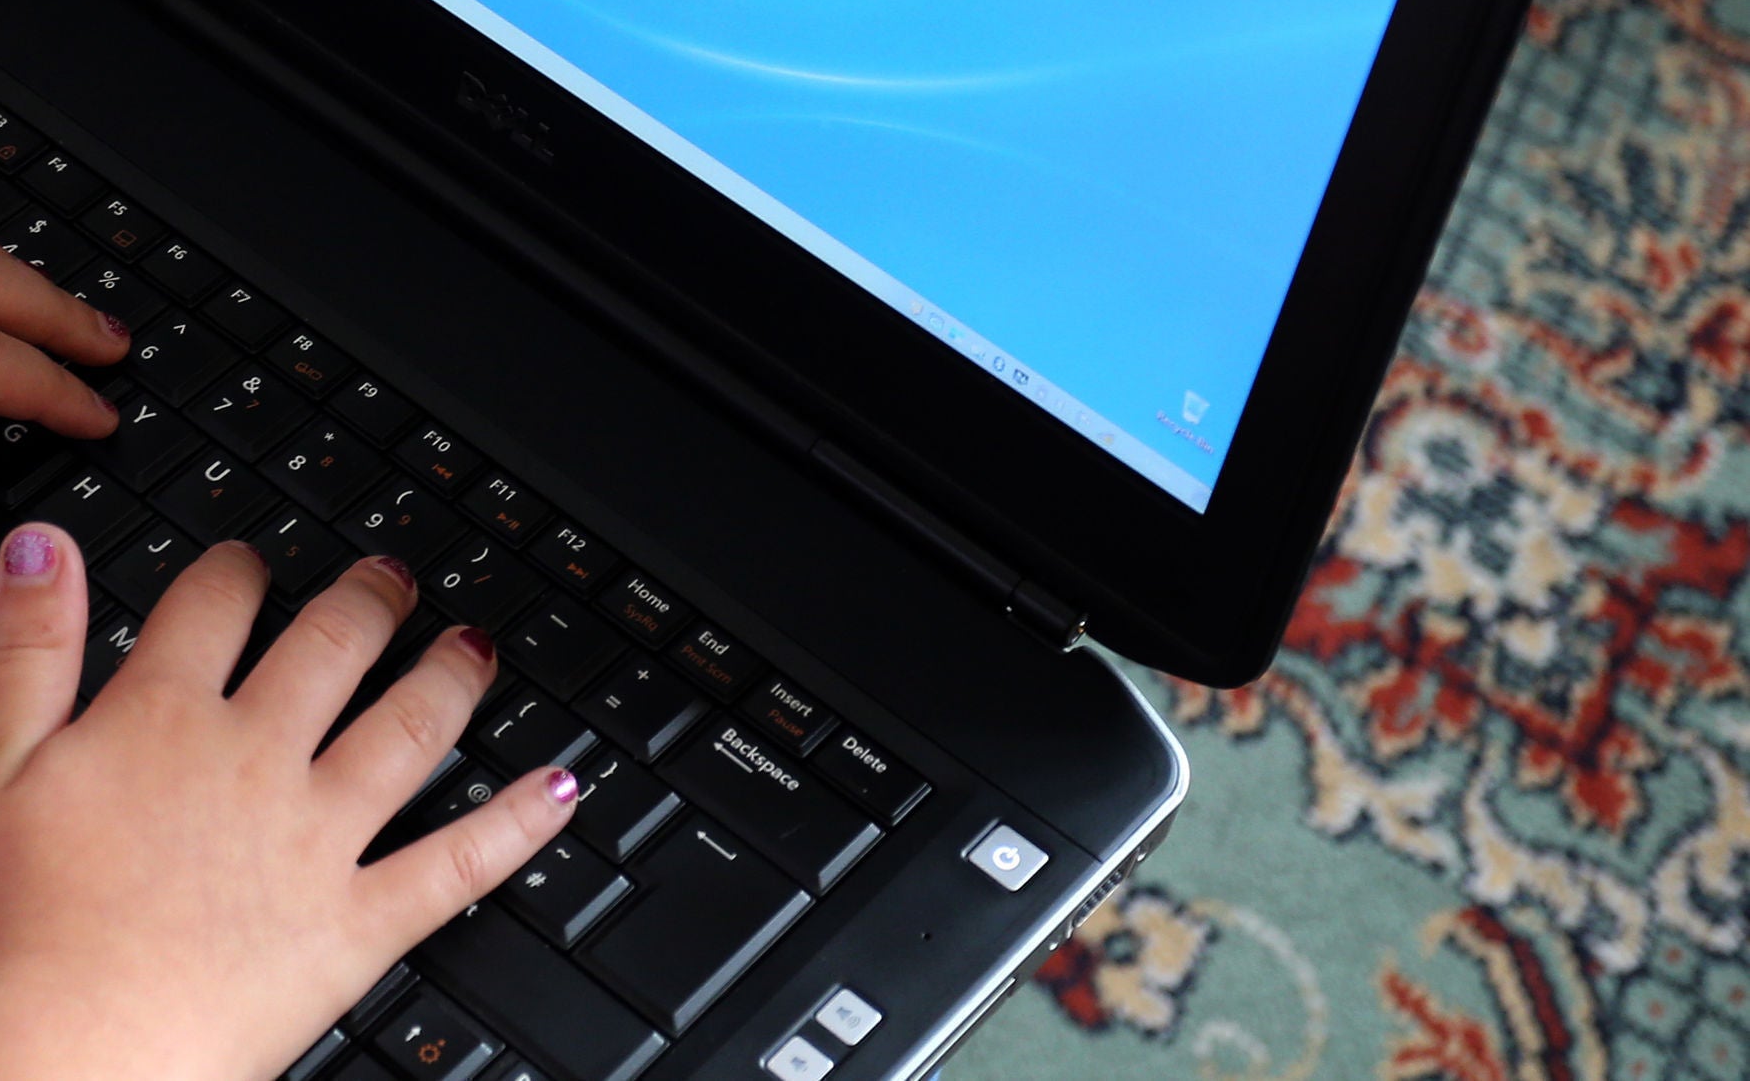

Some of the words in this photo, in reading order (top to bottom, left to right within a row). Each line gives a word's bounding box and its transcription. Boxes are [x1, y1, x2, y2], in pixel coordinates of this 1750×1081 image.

[48, 157, 67, 172] F4
[108, 200, 127, 216] F5
[29, 220, 47, 233] $
[167, 244, 188, 260] F6
[98, 270, 121, 289] %
[230, 288, 252, 304] F7
[292, 334, 314, 352] F8
[141, 345, 159, 360] 6
[242, 376, 262, 394] &
[358, 382, 379, 398] F9
[134, 405, 157, 424] Y
[213, 398, 234, 413] 7
[4, 424, 28, 442] G
[422, 430, 451, 452] F10
[204, 461, 231, 482] U
[288, 455, 306, 471] 8
[72, 476, 102, 500] H
[489, 478, 516, 502] F11
[279, 519, 297, 534] I
[365, 513, 384, 528] 9
[147, 538, 172, 554] J
[558, 528, 586, 552] F12
[628, 578, 670, 613] Home
[109, 626, 138, 653] M
[698, 630, 730, 657] End
[770, 683, 814, 717] Insert
[768, 709, 805, 737] Pause
[721, 728, 800, 792] Backspace
[842, 736, 888, 774] Delete
[468, 783, 492, 804] @
[525, 871, 547, 888] #
